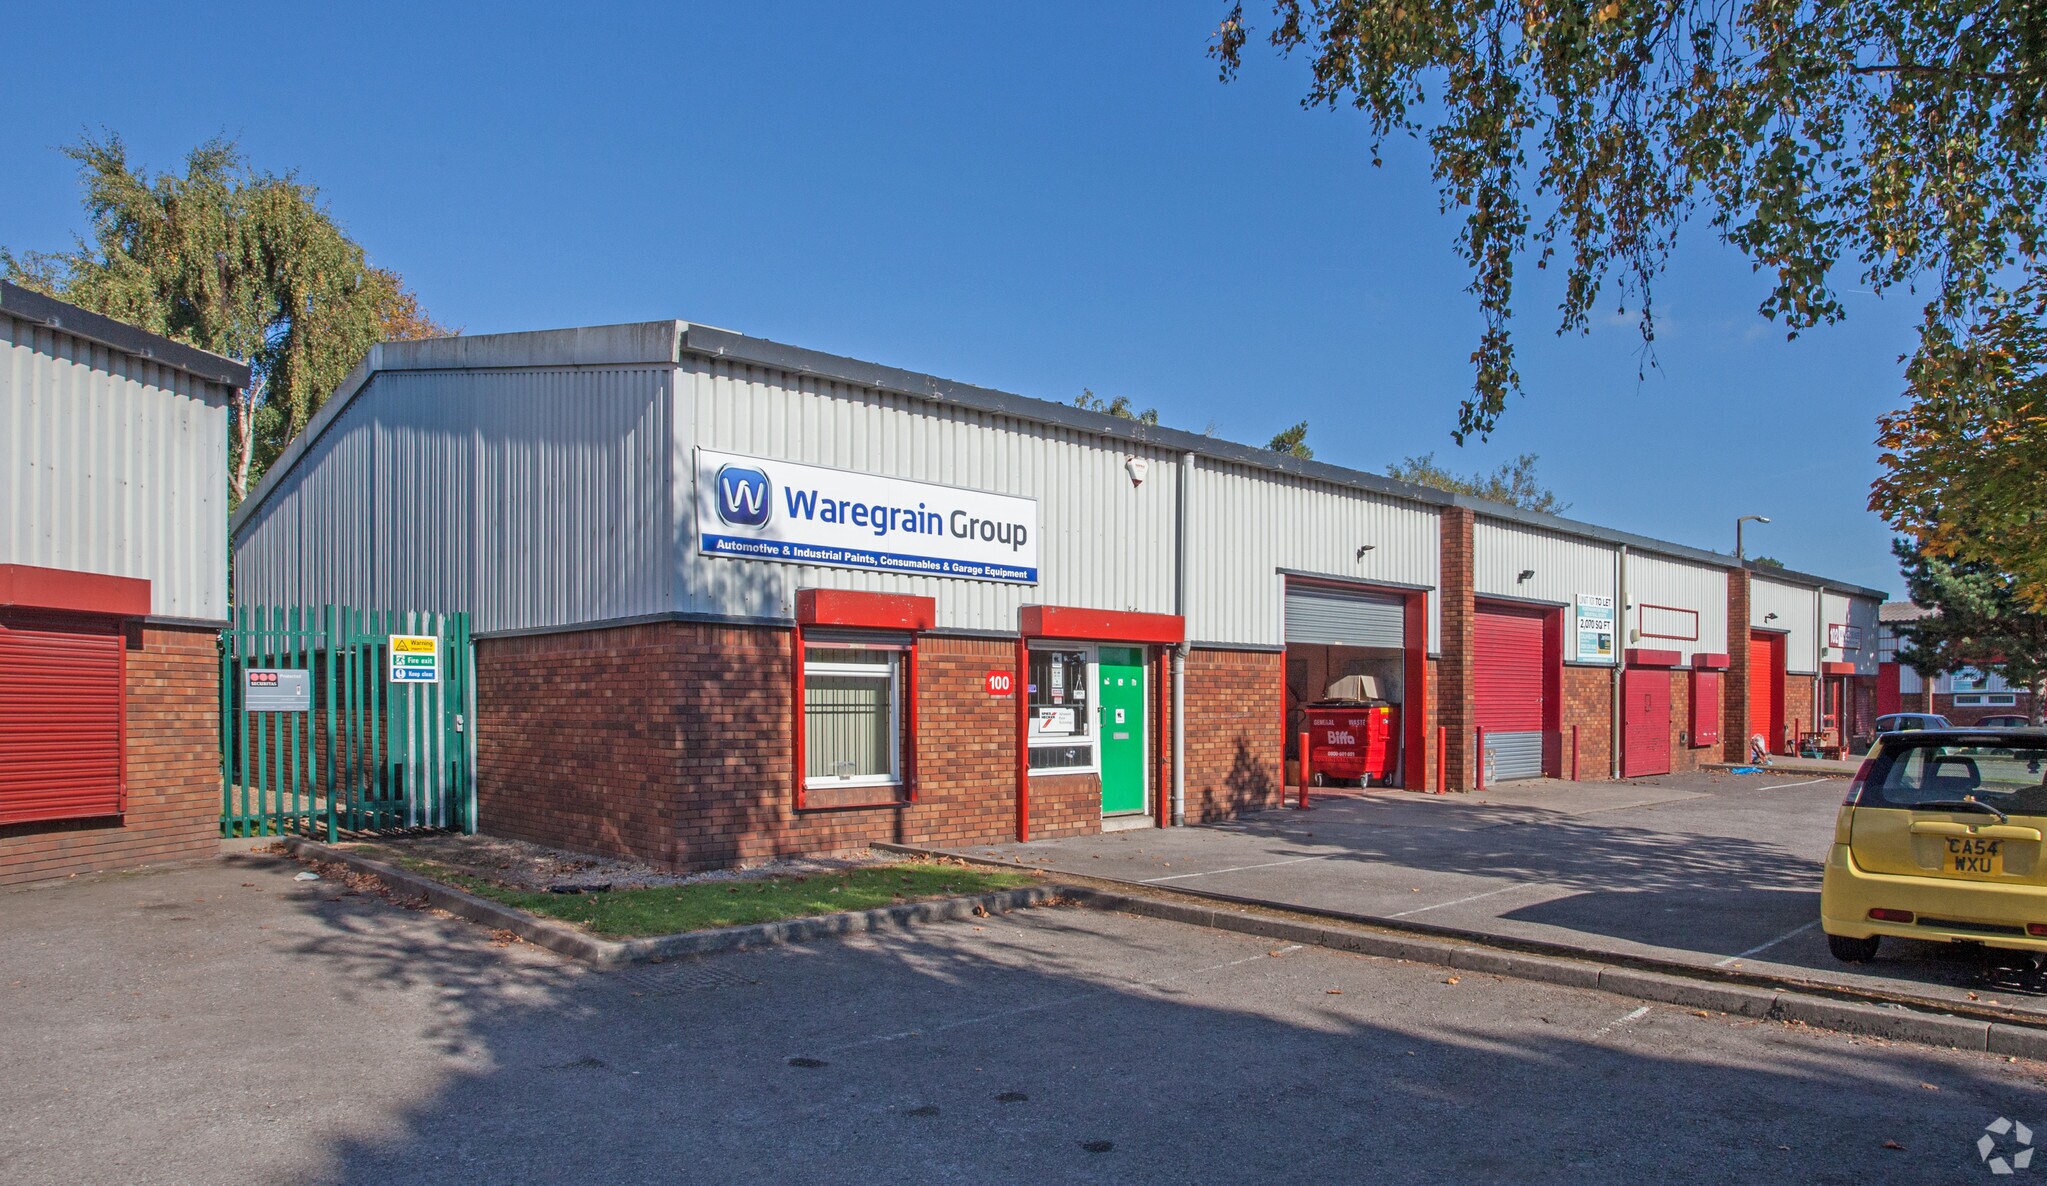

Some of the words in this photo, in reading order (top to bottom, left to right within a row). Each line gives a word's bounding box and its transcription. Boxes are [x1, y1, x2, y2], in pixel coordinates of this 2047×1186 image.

[784, 486, 943, 537] Waregrain
[950, 509, 1027, 552] Group
[716, 538, 779, 555] Automotive
[782, 545, 791, 556] &
[793, 546, 842, 561] Industrial
[844, 552, 878, 566] Paints,
[880, 555, 940, 571] Consumables
[943, 561, 950, 571] &
[952, 562, 983, 576] Garage
[985, 565, 1027, 580] Equipment
[1595, 598, 1602, 606] TO
[1603, 598, 1611, 607] LET
[1580, 619, 1595, 630] 2,070
[1595, 620, 1602, 630] SQ
[1603, 621, 1610, 630] FT
[989, 675, 1010, 690] 100
[1327, 731, 1355, 744] Biffa
[1949, 838, 1998, 856] CA54
[1955, 857, 1991, 873] WXU
